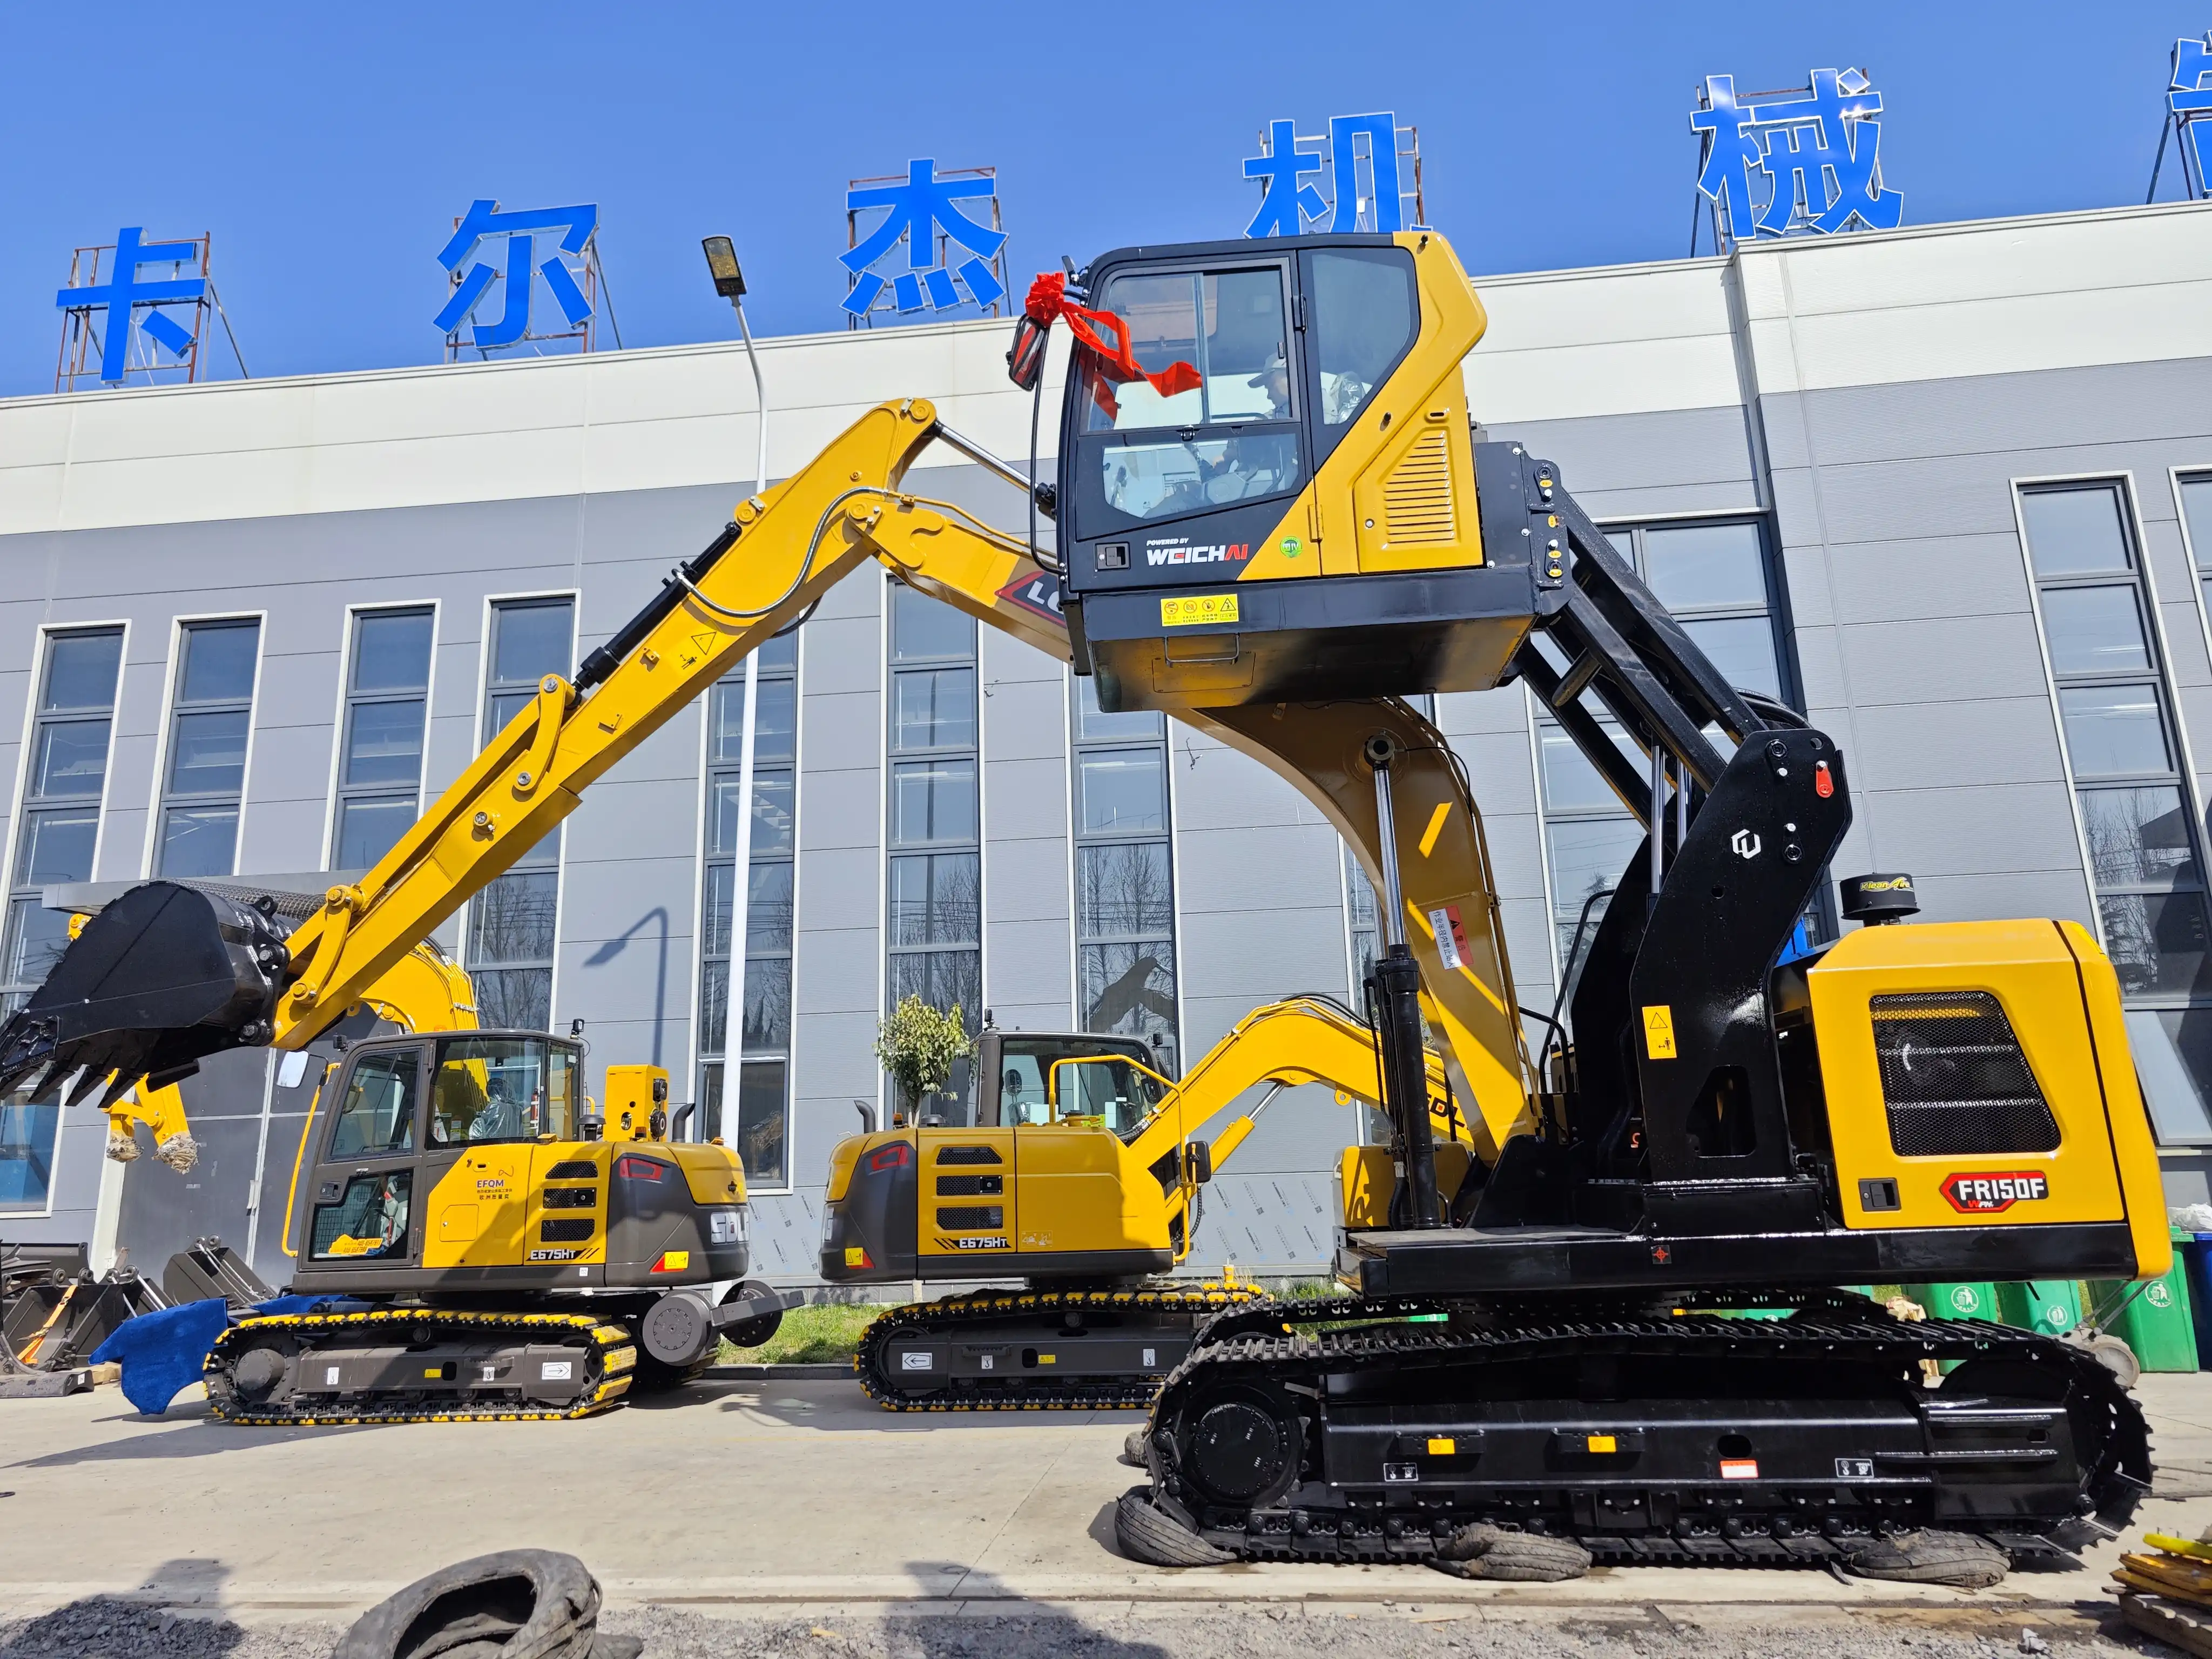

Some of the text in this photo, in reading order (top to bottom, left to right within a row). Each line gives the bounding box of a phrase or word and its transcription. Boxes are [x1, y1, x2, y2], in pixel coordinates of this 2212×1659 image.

[1146, 544, 1249, 567] WEICHAI
[1433, 911, 1456, 968] 作业半径内禁止站人
[477, 1179, 504, 1188] EFQM
[1958, 1178, 2045, 1201] FR150F
